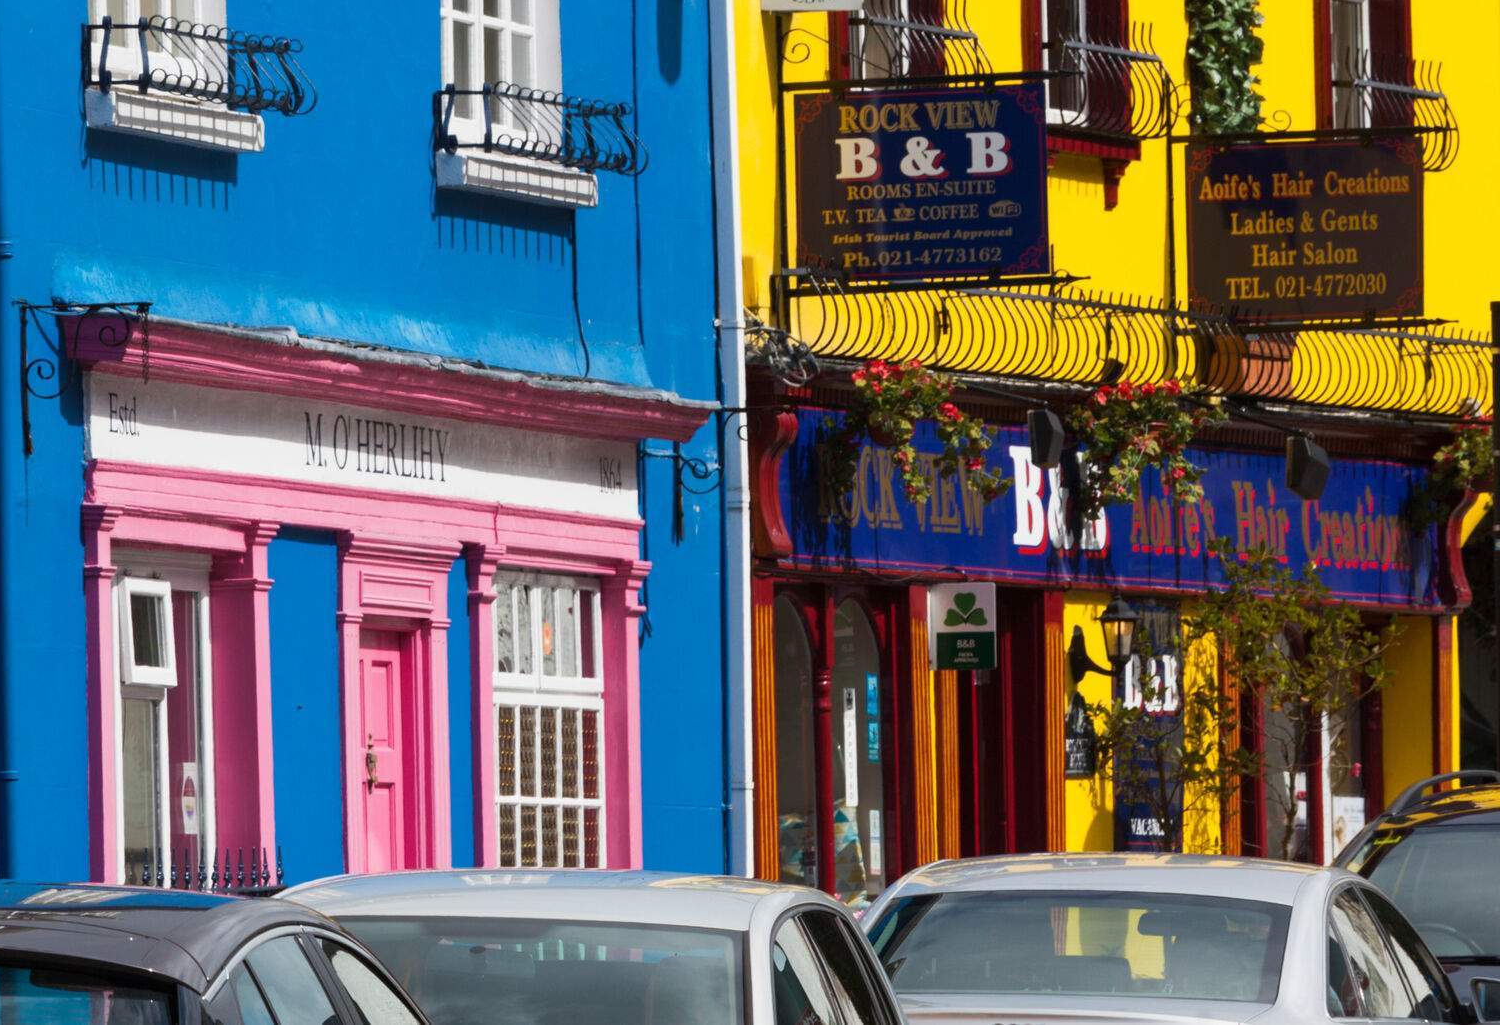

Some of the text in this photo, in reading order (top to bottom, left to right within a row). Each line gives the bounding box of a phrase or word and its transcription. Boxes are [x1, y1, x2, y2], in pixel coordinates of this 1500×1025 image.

[838, 100, 1000, 134] ROCK VIEW
[835, 131, 1011, 181] B & B
[846, 179, 996, 201] ROOMS EN-SUITE
[1199, 168, 1410, 201] Aoife's Hair Creations
[821, 209, 850, 224] T.V.
[855, 207, 888, 223] TEA
[919, 204, 979, 221] COFFEE
[1230, 208, 1378, 236] Ladies & Gents
[832, 227, 1013, 245] Irish Tourist Board Approved
[842, 247, 1002, 269] Ph.021-4773162
[1251, 241, 1358, 268] Hair Salon
[1226, 272, 1388, 300] TEL. 021-4772030
[108, 392, 140, 438] Estd.
[305, 411, 328, 468] M.
[599, 457, 622, 494] 1864
